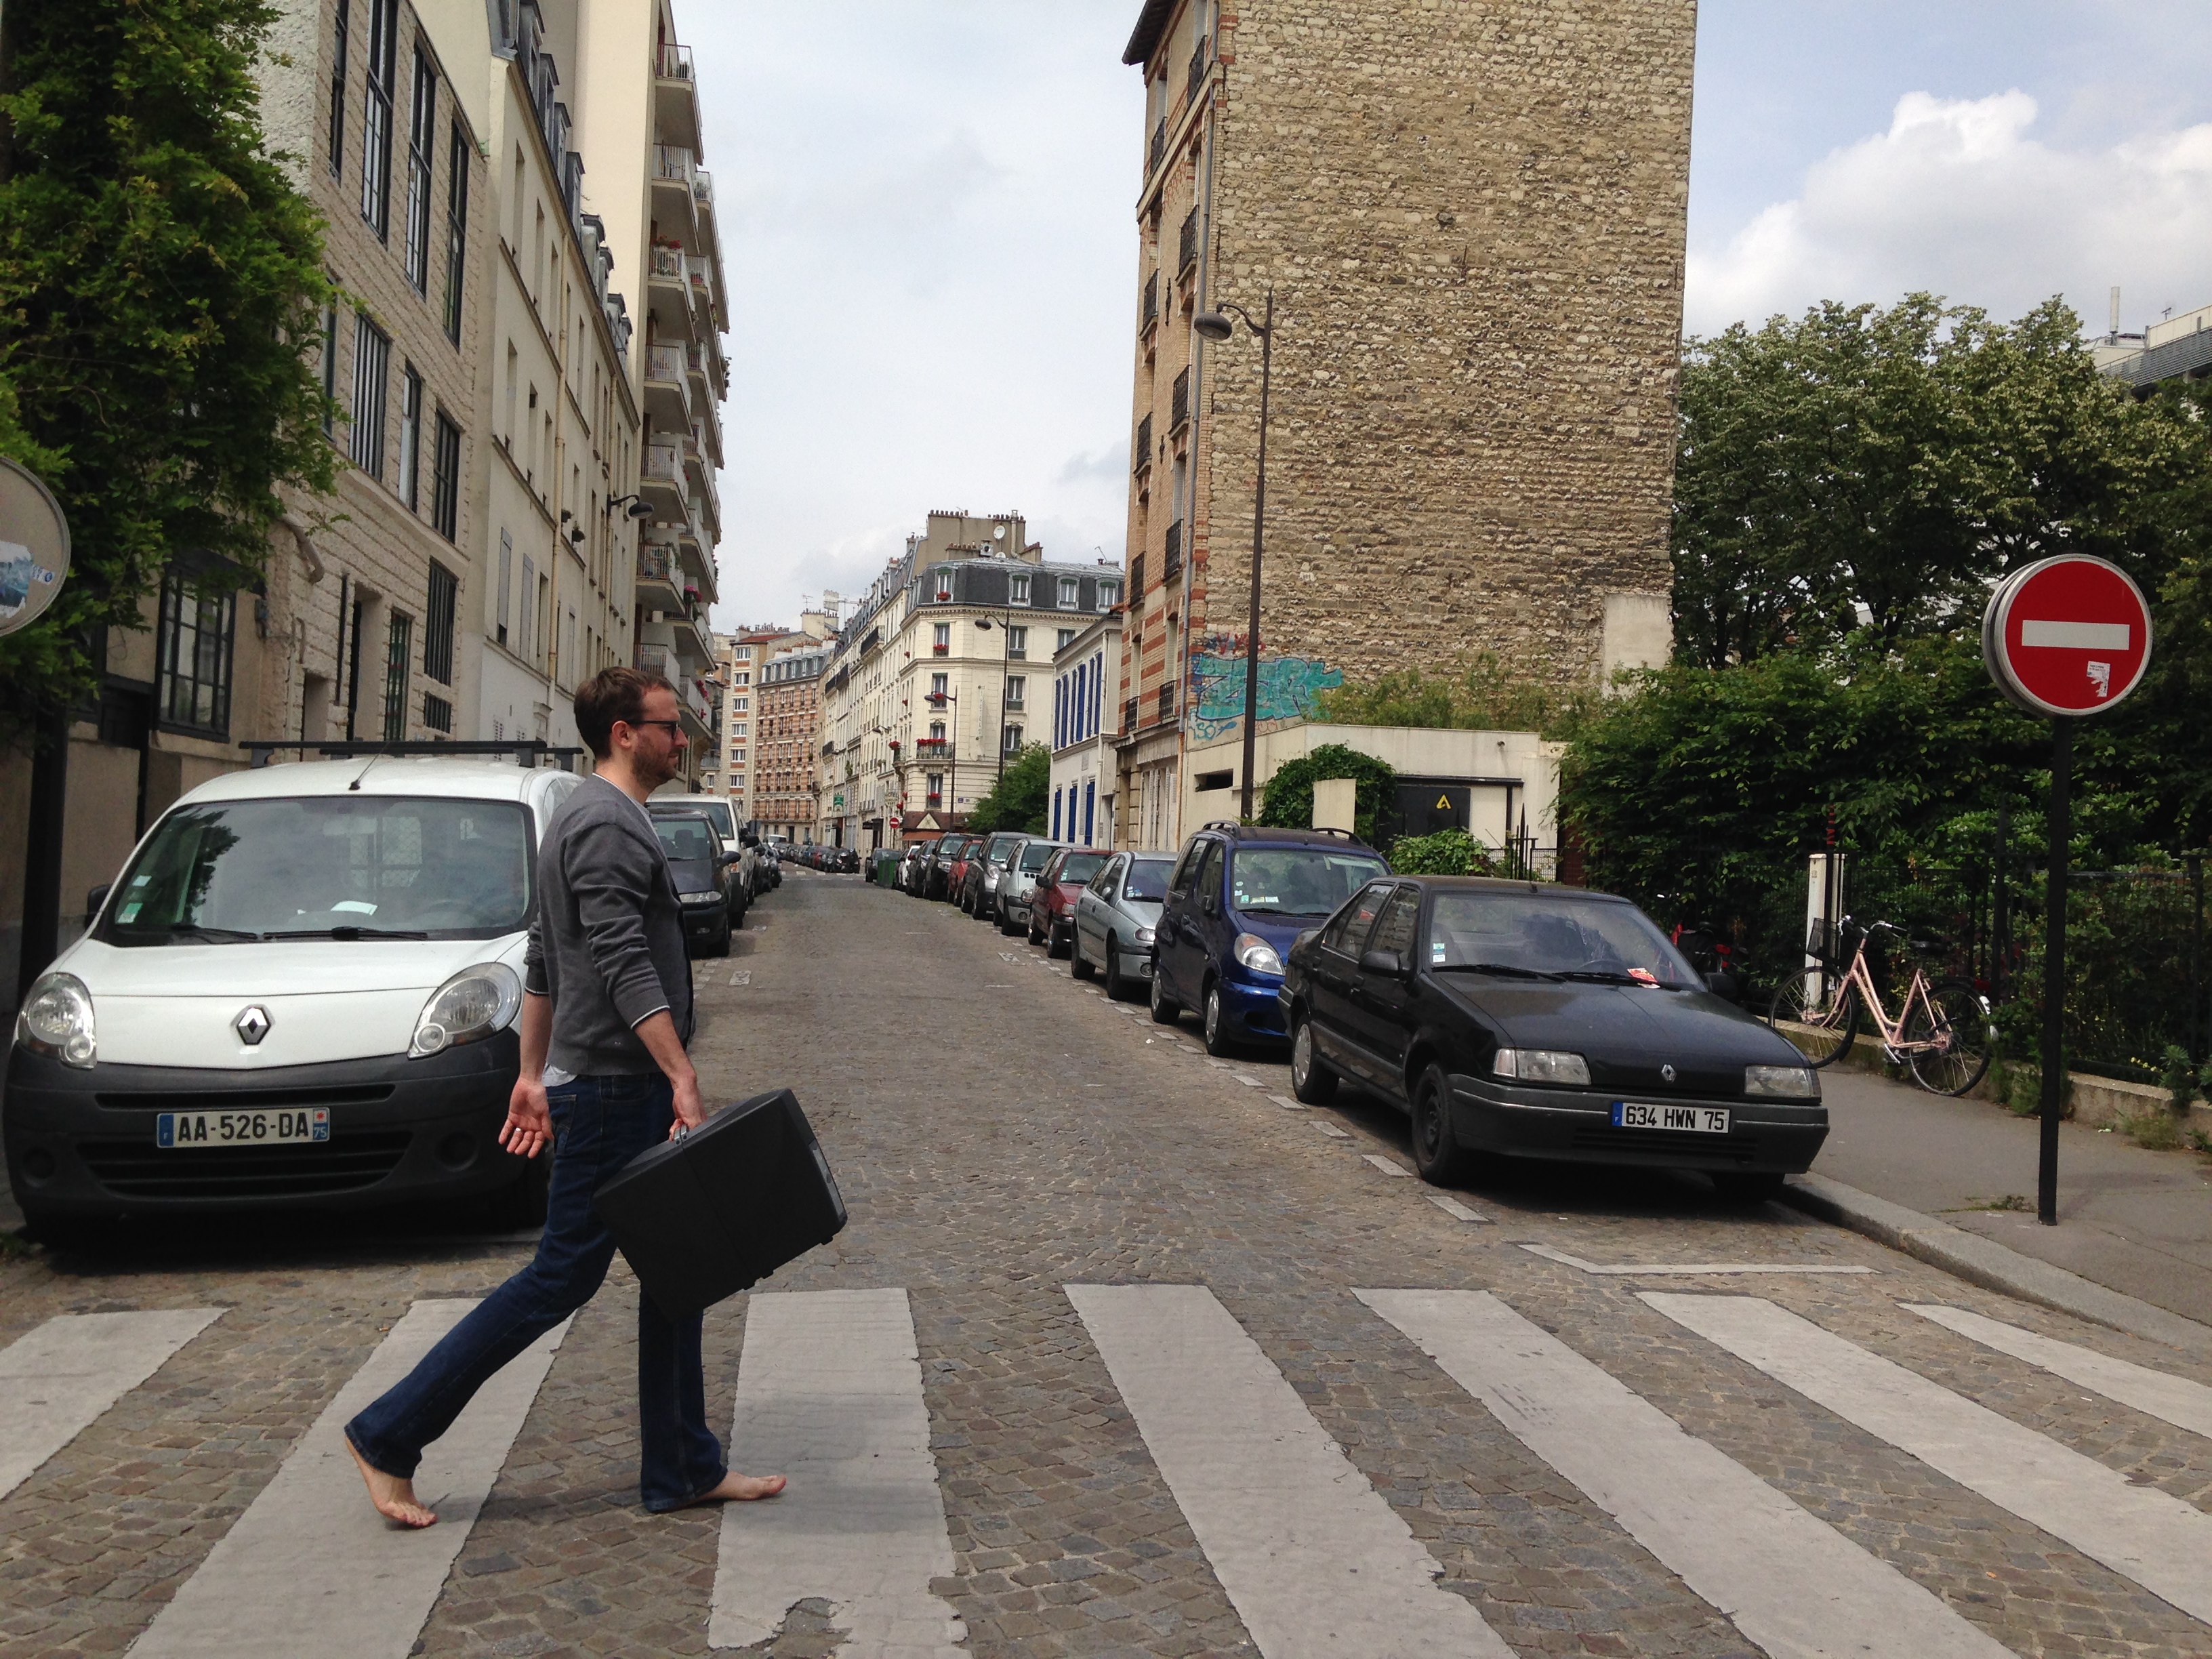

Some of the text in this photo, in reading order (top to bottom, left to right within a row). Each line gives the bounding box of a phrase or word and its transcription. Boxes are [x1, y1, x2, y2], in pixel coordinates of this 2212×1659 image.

[178, 1112, 309, 1141] AA-526-DA
[1626, 1106, 1725, 1130] 634 HWN 75
[314, 1126, 327, 1139] 75
